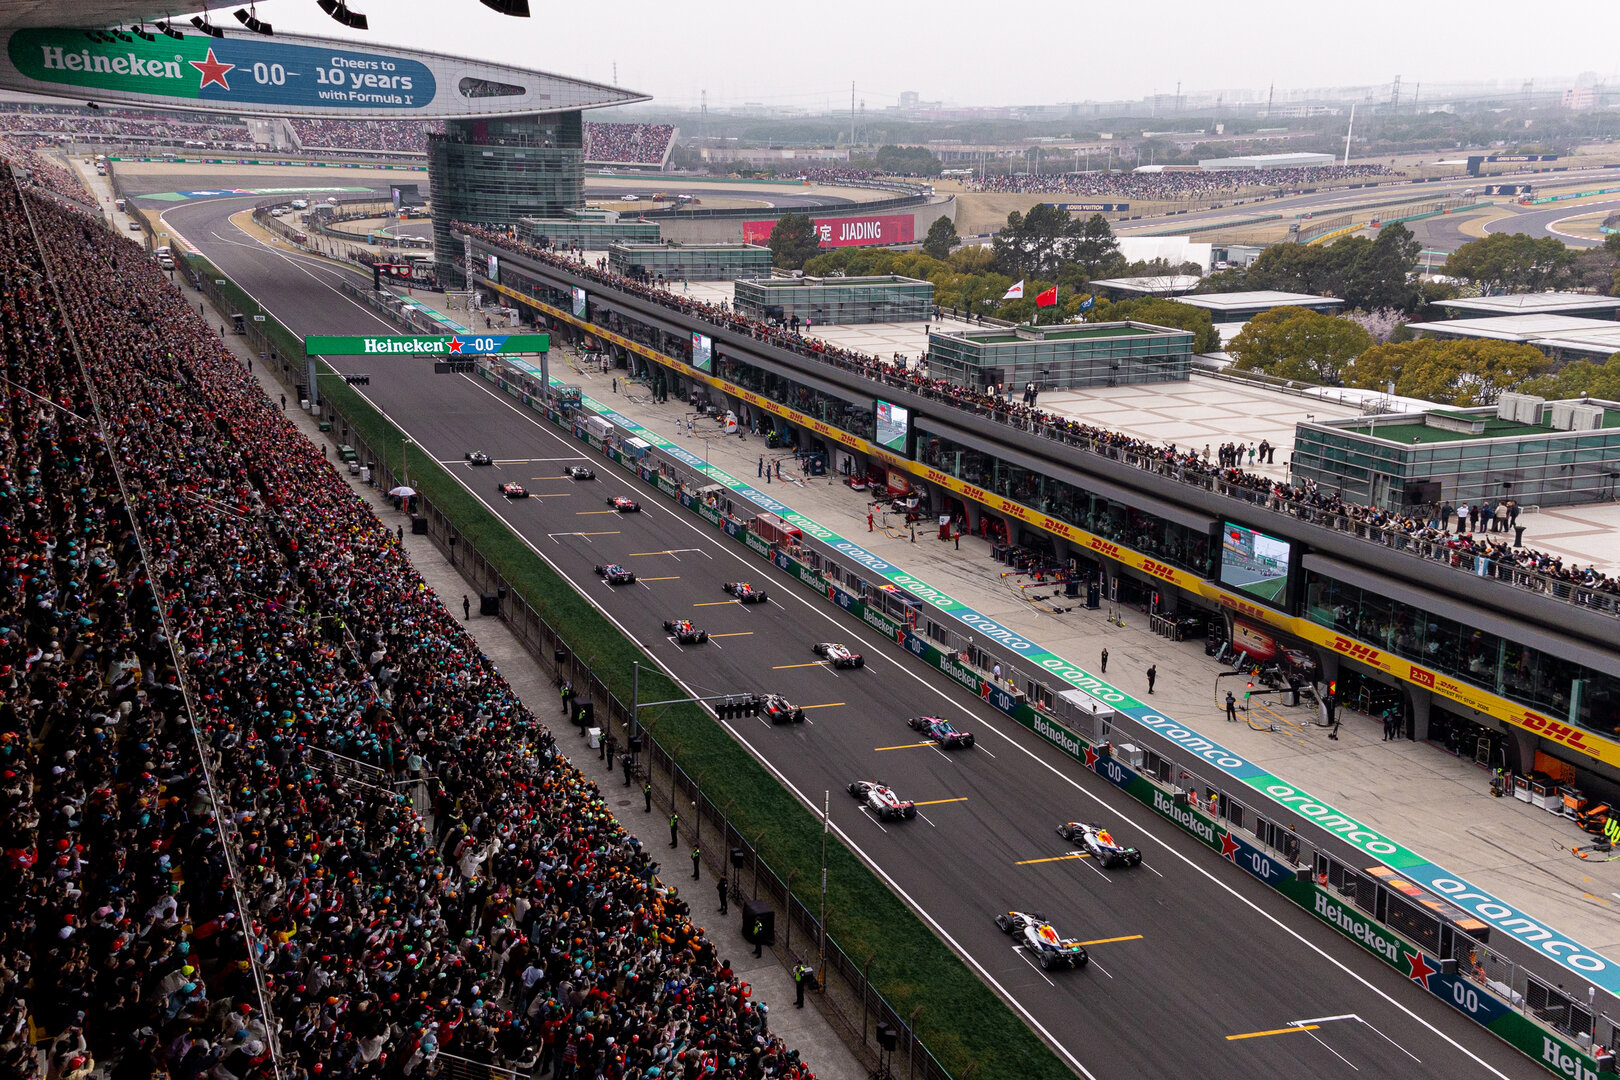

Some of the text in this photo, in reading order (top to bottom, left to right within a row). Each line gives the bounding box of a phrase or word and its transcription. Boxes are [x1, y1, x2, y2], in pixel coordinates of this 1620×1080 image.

[41, 46, 183, 78] Heineken
[331, 57, 396, 71] Cheers to
[316, 67, 413, 90] 10 years
[318, 90, 347, 101] with
[349, 91, 402, 104] Formula
[839, 221, 881, 241] JIADING
[364, 338, 444, 353] Heineken
[723, 384, 736, 394] DHL
[745, 393, 757, 403] DHL
[766, 402, 779, 413] DHL
[789, 411, 804, 423] DHL
[814, 422, 830, 435] DHL
[840, 433, 857, 447] DHL
[927, 470, 947, 486] DHL
[742, 489, 785, 511] aramco
[963, 484, 985, 502] DHL
[1001, 501, 1025, 519] DHL
[787, 514, 832, 538] aramco
[1044, 518, 1071, 537] DHL
[745, 534, 769, 556] Heineken
[836, 543, 888, 569] aramco
[1090, 537, 1120, 559] DHL
[800, 568, 826, 593] Heineken
[1142, 559, 1175, 582] DHL
[894, 575, 953, 606] aramco
[864, 608, 894, 637] Heineken
[961, 614, 1031, 650] aramco
[1333, 636, 1381, 666] DHL
[940, 655, 977, 690] Heineken
[1042, 659, 1125, 702] aramco
[1435, 686, 1455, 697] FASTEST
[1463, 697, 1476, 705] STOP
[1440, 681, 1459, 693] DHL
[1033, 714, 1080, 757] Heineken
[1141, 715, 1243, 768] aramco
[1522, 712, 1588, 750] DHL
[1153, 789, 1214, 843] Heineken
[1266, 785, 1397, 854] aramco
[1314, 891, 1398, 963] Heineken
[1431, 878, 1606, 971] aramco
